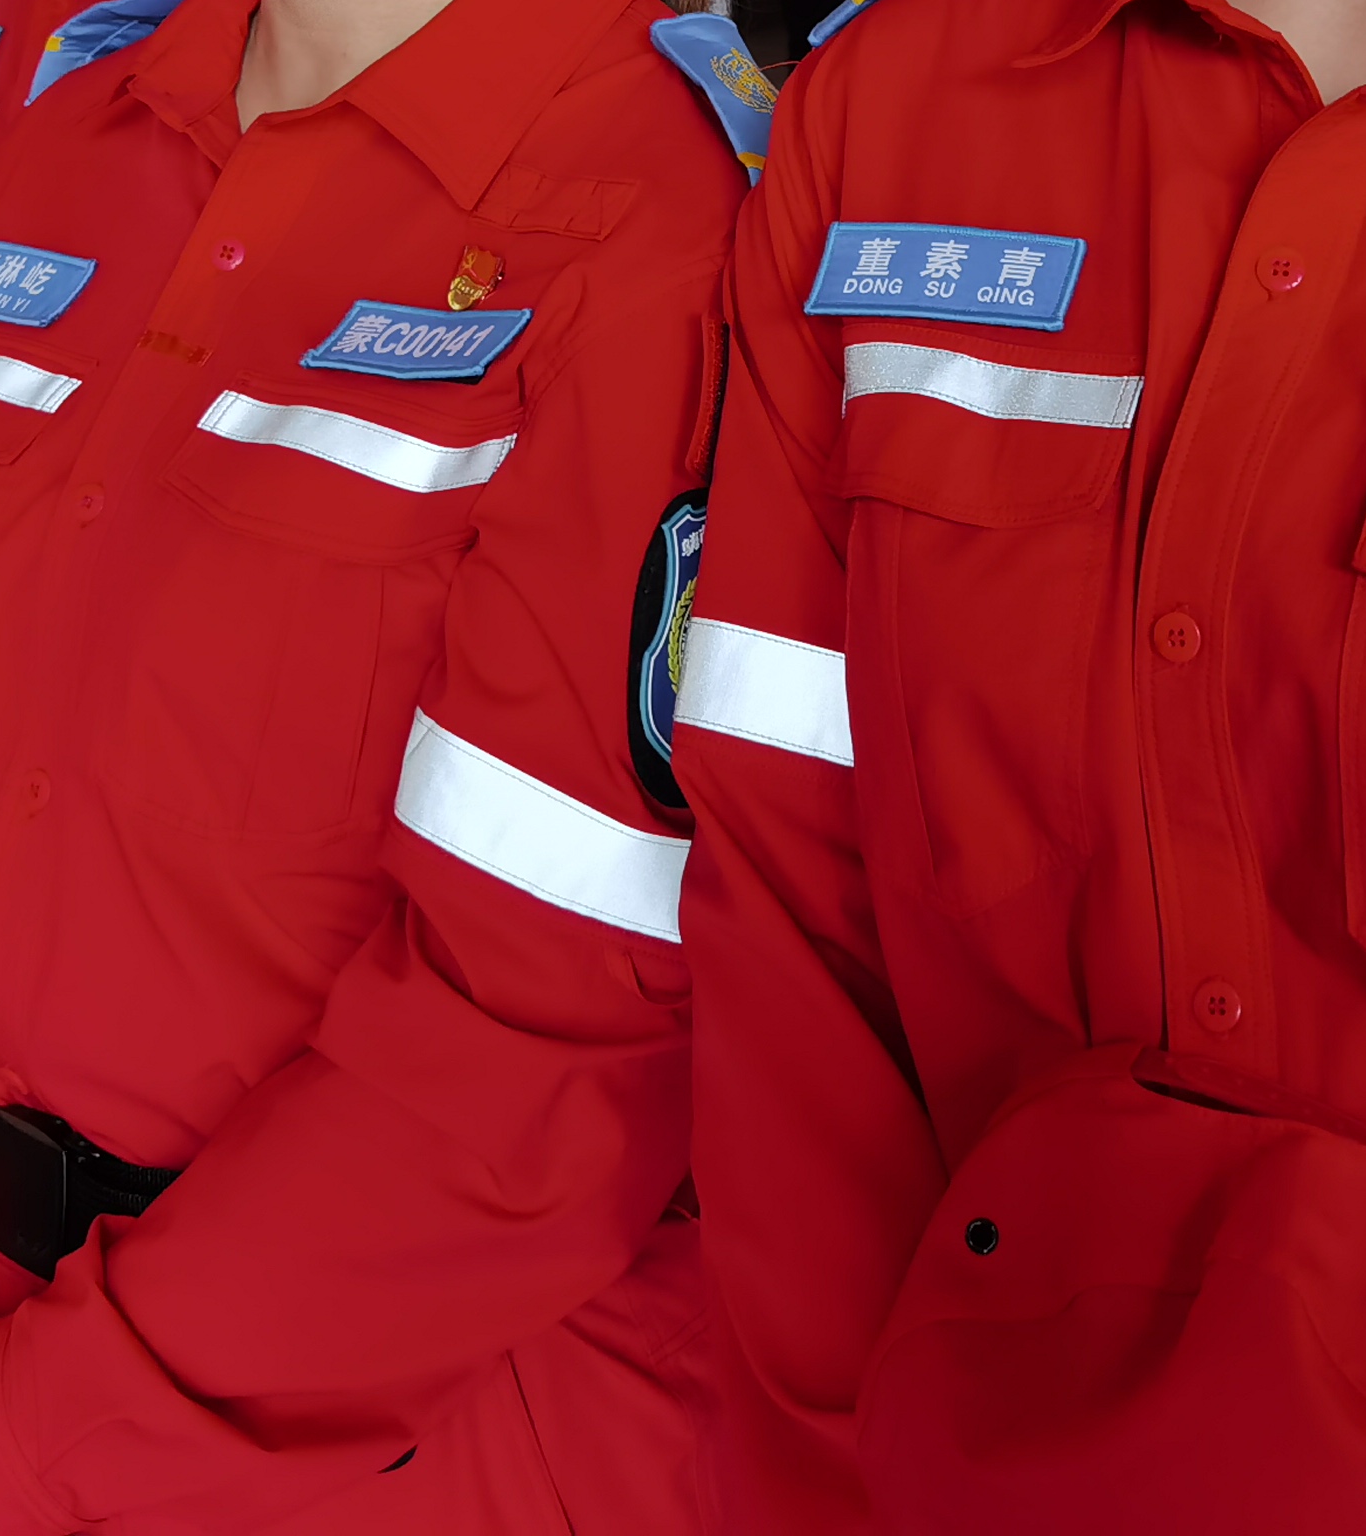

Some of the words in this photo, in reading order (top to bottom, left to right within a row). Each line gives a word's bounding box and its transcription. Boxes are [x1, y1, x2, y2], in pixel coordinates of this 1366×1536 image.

[851, 237, 1047, 288] 董素青
[12, 297, 32, 313] YI
[842, 278, 904, 295] DONG
[923, 281, 957, 299] SU
[976, 286, 1036, 307] QING
[331, 313, 495, 358] 蒙C00141
